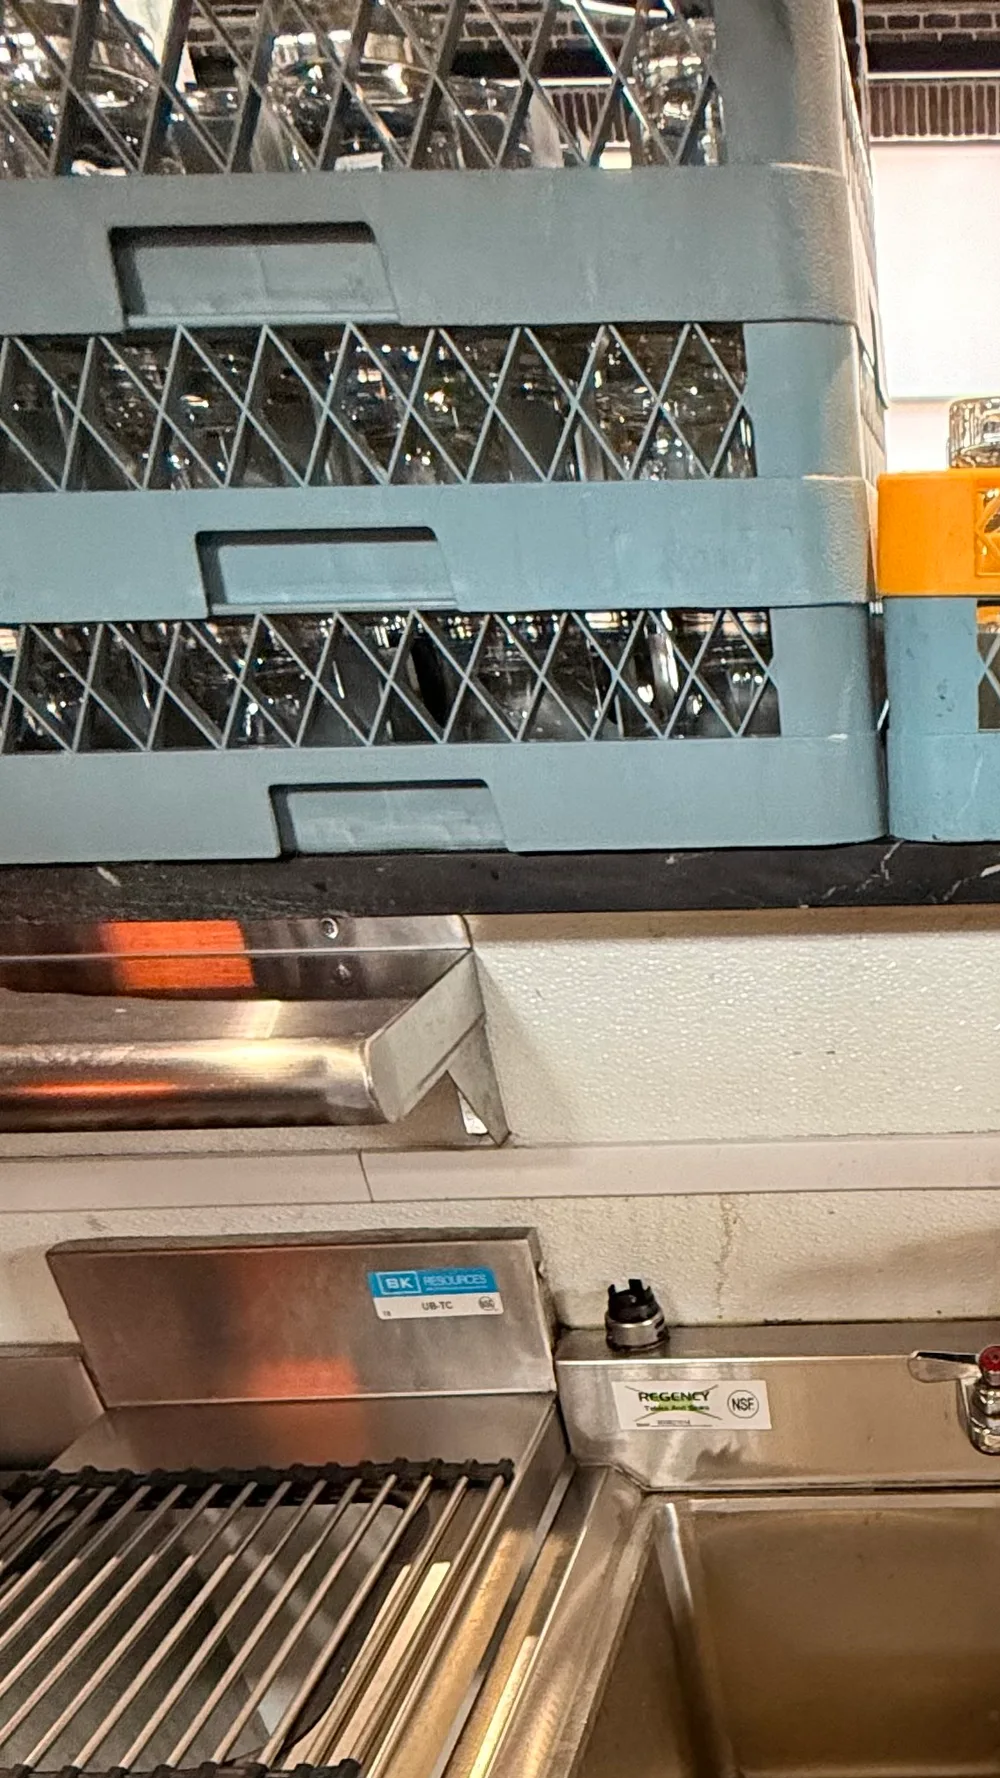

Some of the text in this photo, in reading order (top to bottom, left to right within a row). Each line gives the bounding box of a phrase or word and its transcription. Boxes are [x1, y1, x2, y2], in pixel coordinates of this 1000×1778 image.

[385, 1274, 488, 1290] BK RESOURCES
[421, 1300, 454, 1311] UB-TC
[638, 1391, 710, 1402] REGENCY
[731, 1397, 755, 1412] NSF
